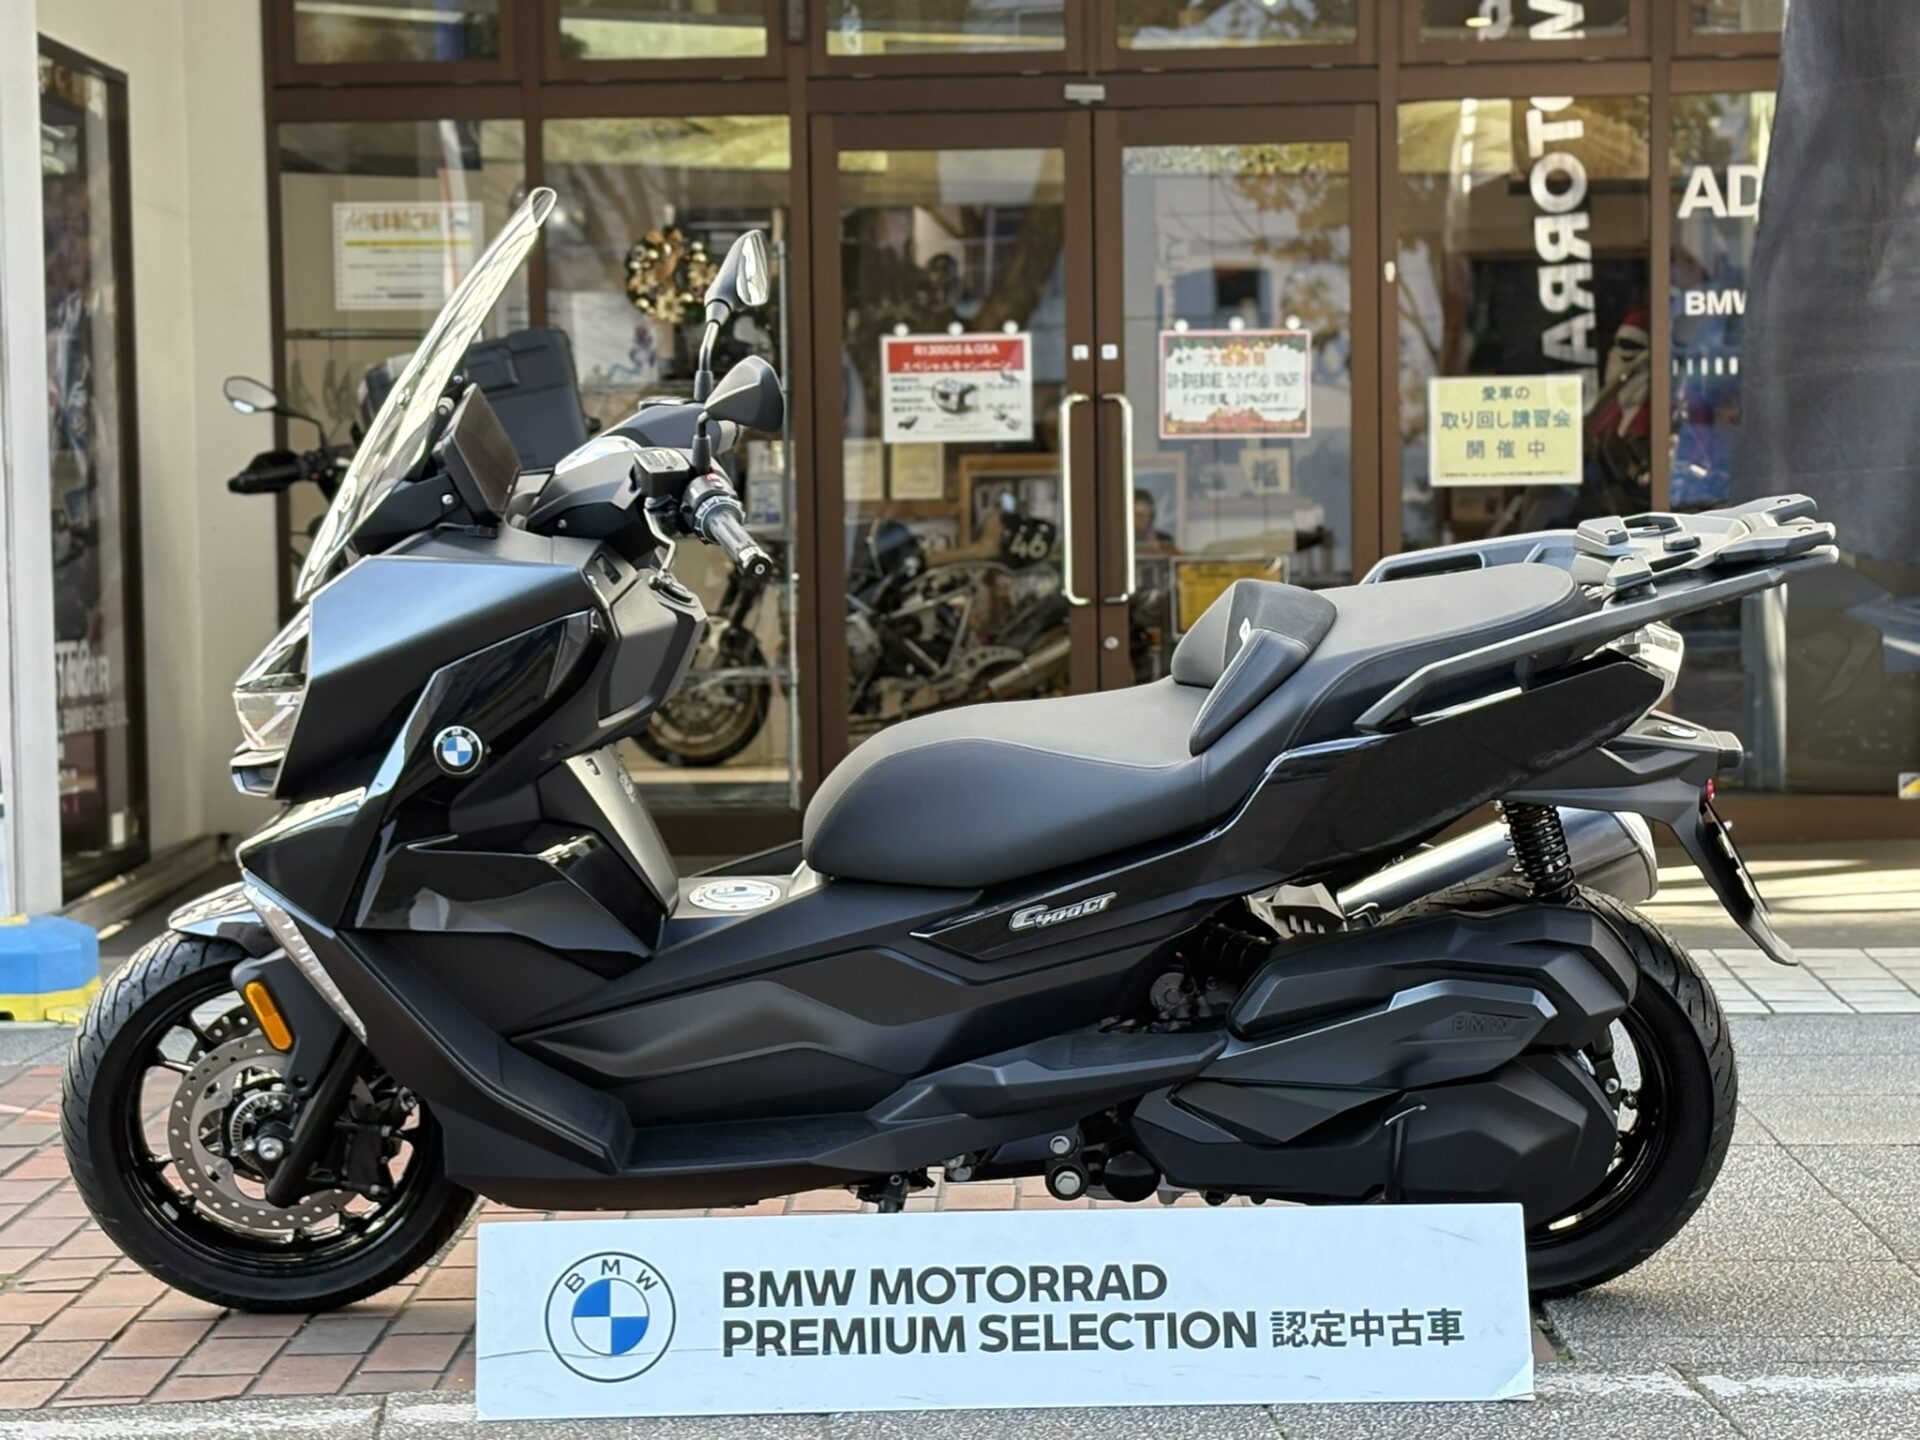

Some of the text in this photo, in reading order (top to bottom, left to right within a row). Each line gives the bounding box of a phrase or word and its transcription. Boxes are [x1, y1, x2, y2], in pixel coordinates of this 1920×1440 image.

[1481, 385, 1531, 401] 愛車の
[1441, 409, 1572, 430] 取り回し講習会
[723, 1264, 1168, 1308] BMW MOTORRAD
[723, 1308, 1465, 1357] PREMIUM SELECTION 認定中古車
